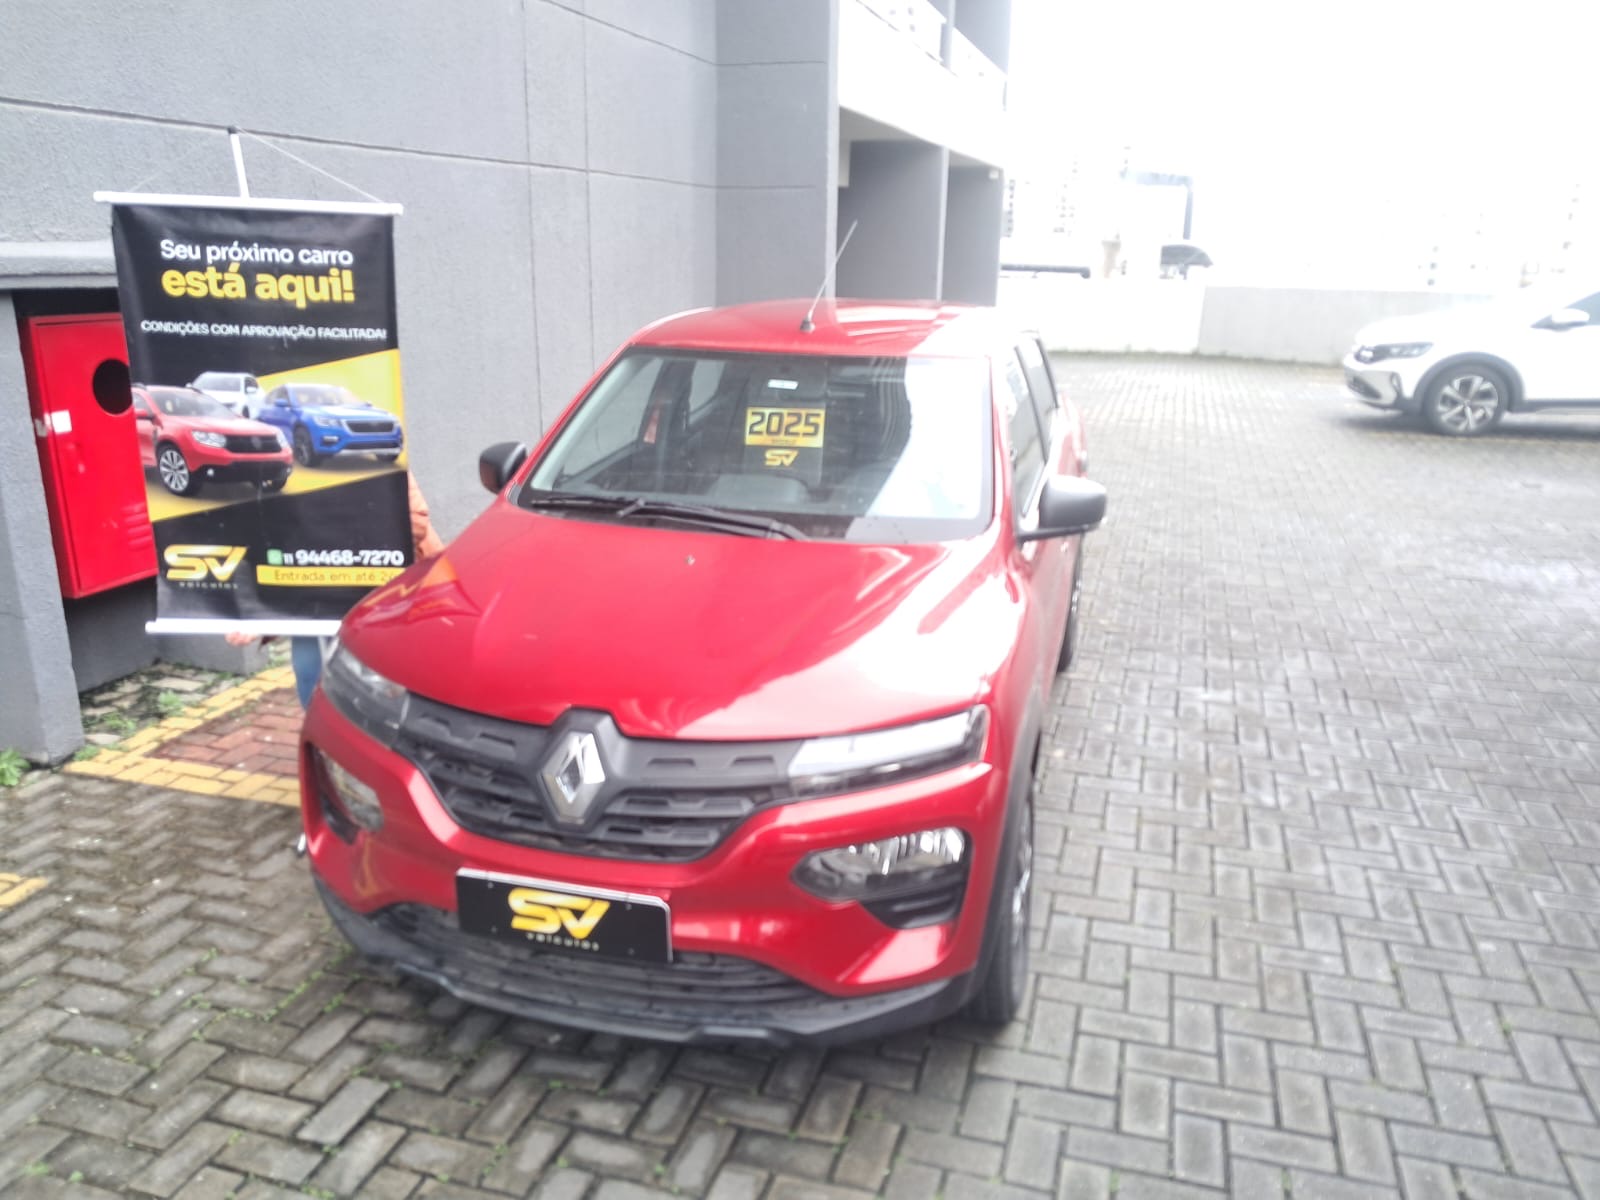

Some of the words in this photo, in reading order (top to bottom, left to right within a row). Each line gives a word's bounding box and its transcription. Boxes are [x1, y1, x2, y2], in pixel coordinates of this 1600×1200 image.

[160, 239, 200, 260] Seu
[206, 241, 294, 264] próximo
[298, 247, 354, 265] carro
[161, 262, 246, 298] está
[255, 268, 355, 309] aqui!
[141, 319, 209, 336] CONDIÇÕES
[211, 325, 240, 336] COM
[241, 325, 316, 340] APROVAÇÃO
[318, 327, 387, 340] FACILITADA!
[749, 411, 821, 436] 2025
[295, 549, 405, 566] 94468-7270
[274, 570, 326, 582] Entrada
[330, 571, 351, 582] em
